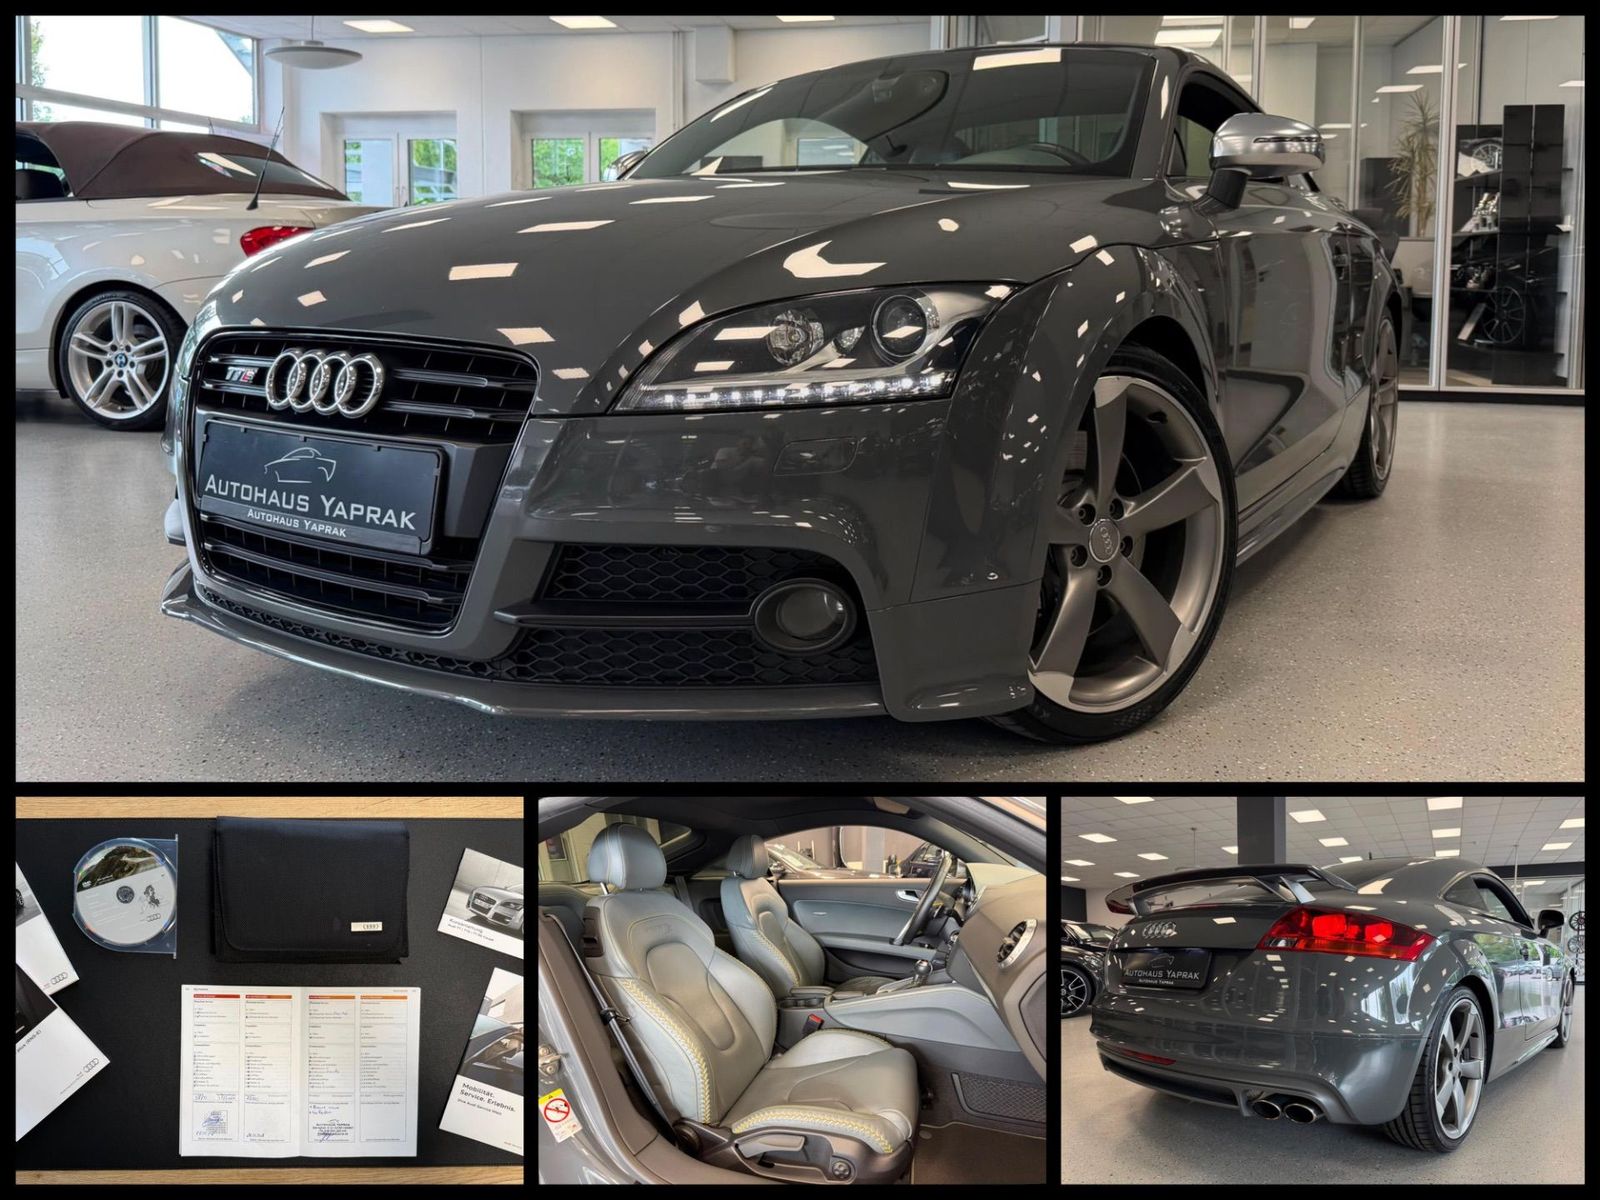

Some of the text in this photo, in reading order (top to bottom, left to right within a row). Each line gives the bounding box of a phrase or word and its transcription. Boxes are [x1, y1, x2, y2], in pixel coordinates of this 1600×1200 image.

[204, 474, 416, 531] AUTOHAUS YAPRAK
[247, 508, 347, 538] AUTOHAUS YAPRAK
[1124, 968, 1200, 980] AUTOHAUS YAPRAK
